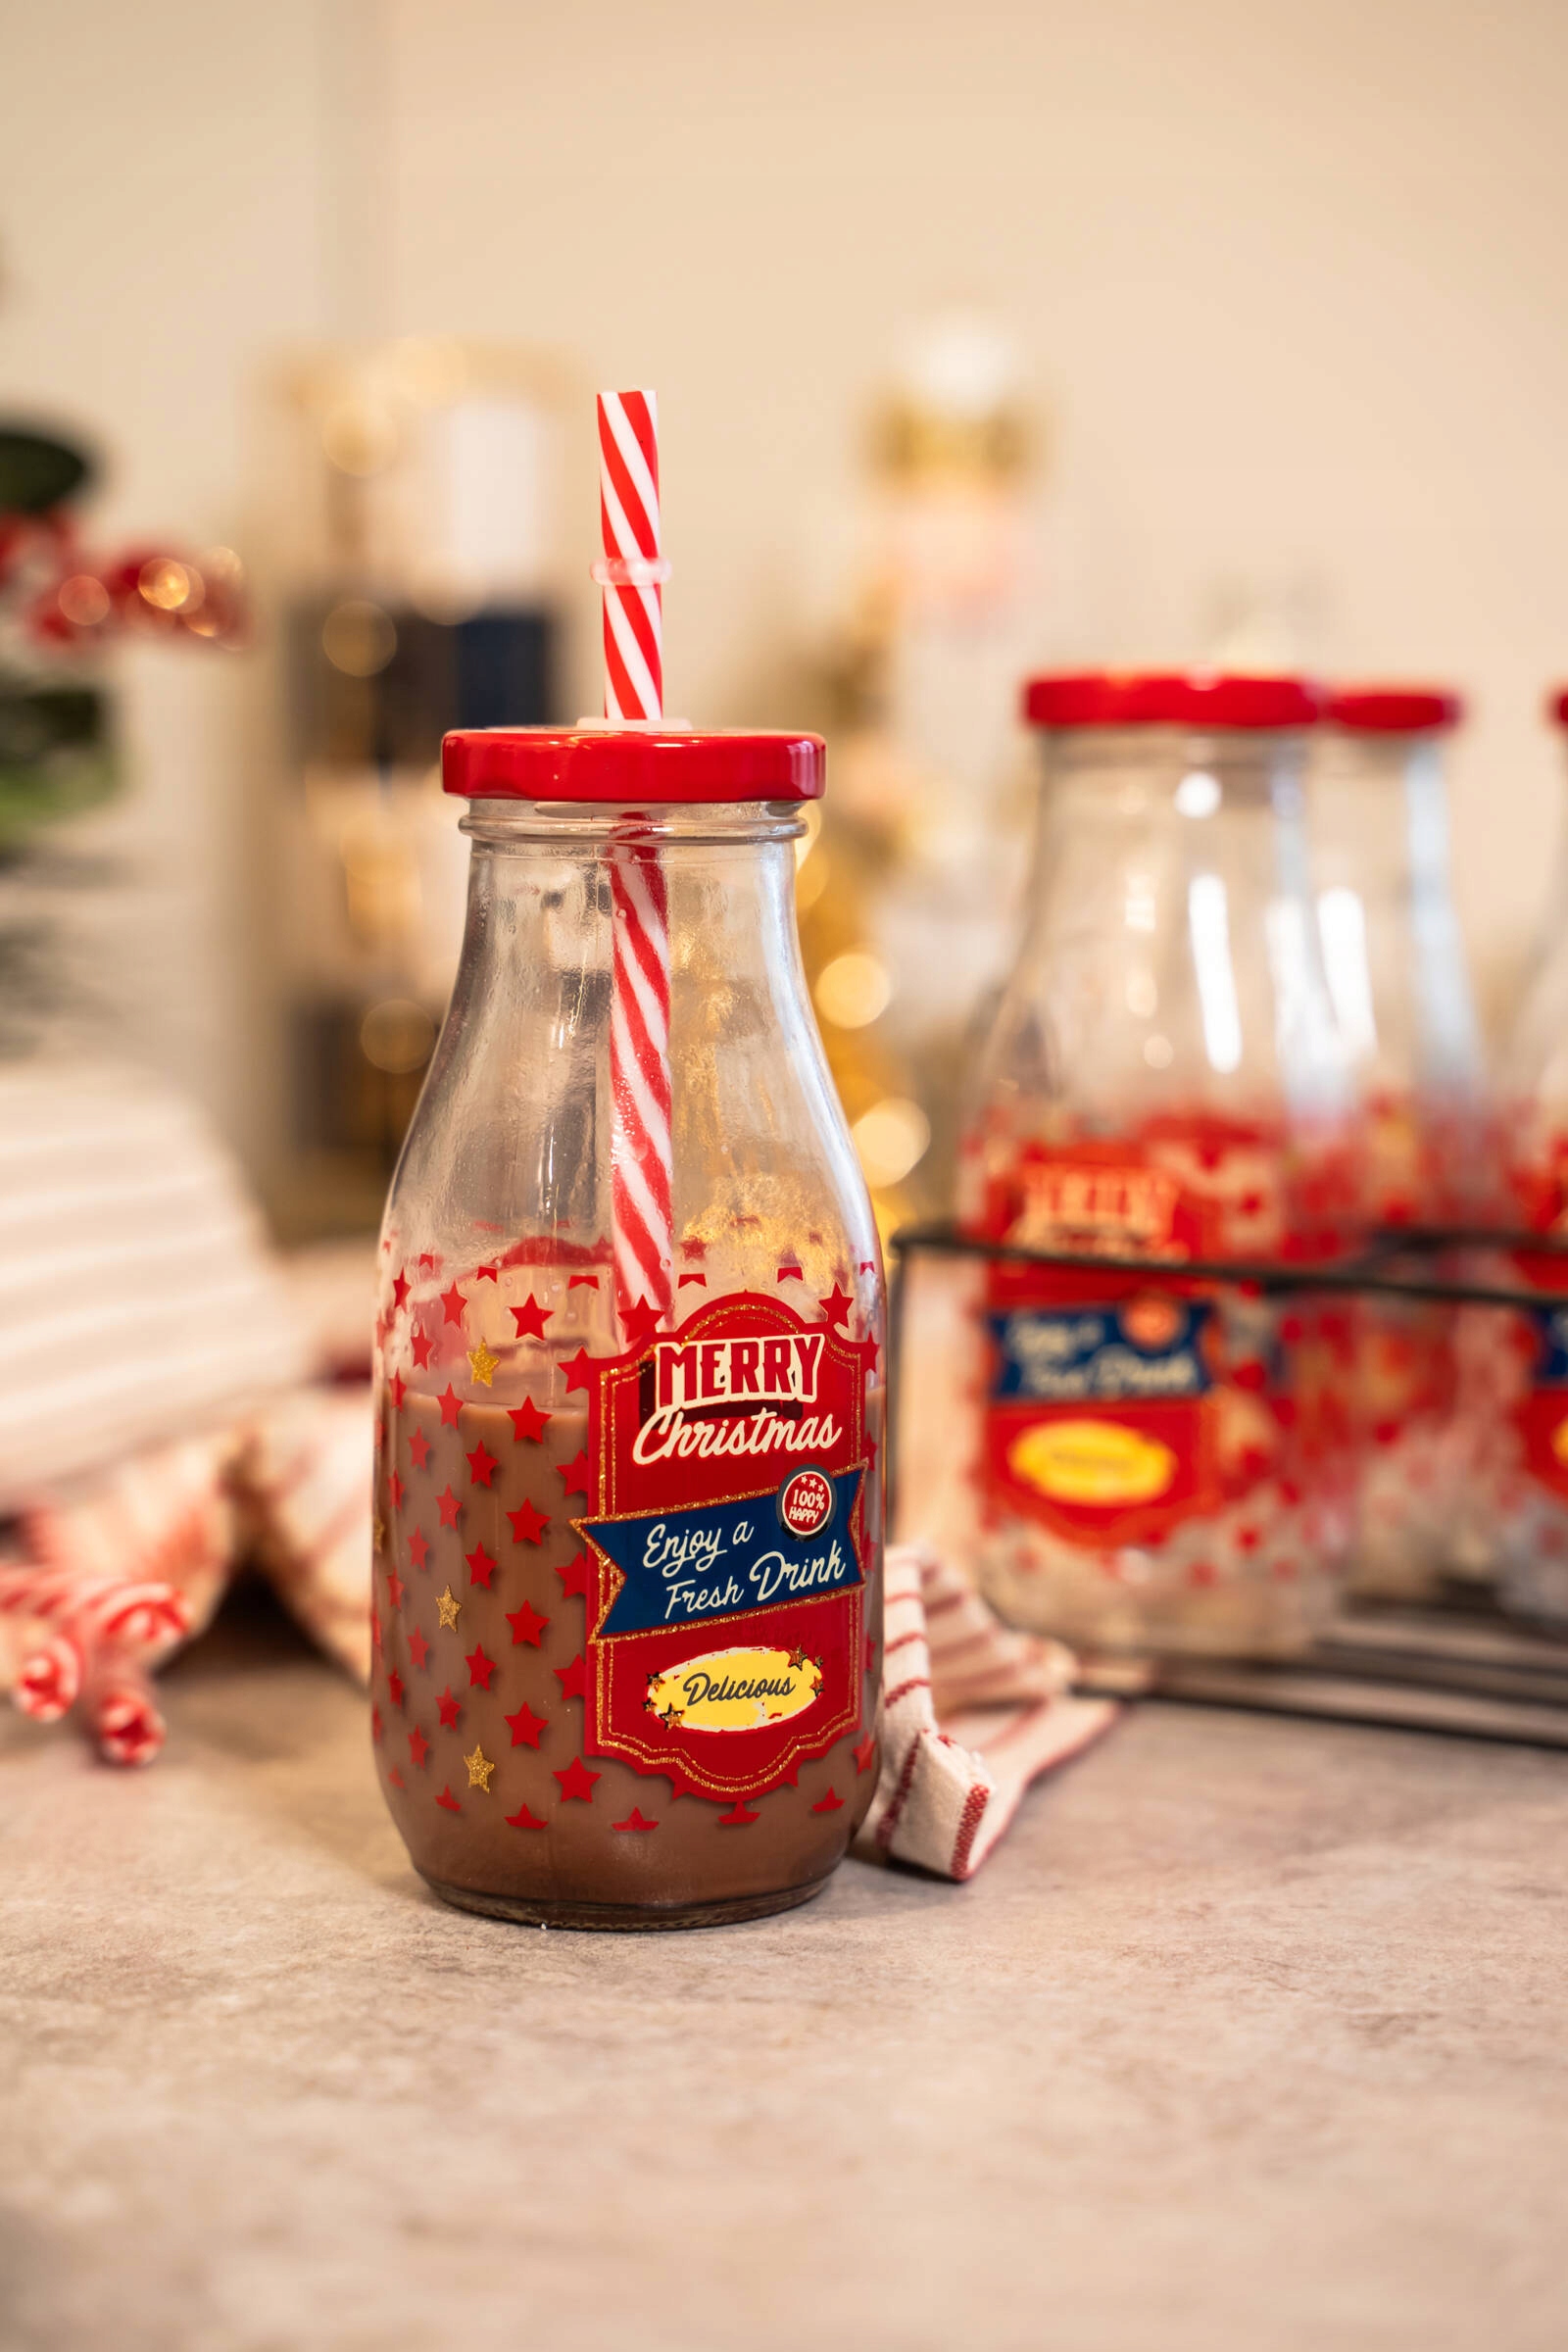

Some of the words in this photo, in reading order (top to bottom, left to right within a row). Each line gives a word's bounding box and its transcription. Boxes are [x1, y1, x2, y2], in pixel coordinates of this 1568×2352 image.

[655, 1334, 825, 1411] MERRY
[633, 1406, 842, 1465] Christmas
[788, 1505, 819, 1525] HAPPY
[792, 1488, 825, 1510] 100%
[643, 1522, 728, 1579] Enjoy
[732, 1519, 755, 1546] a
[663, 1578, 745, 1620] Fresh
[749, 1540, 846, 1601] Drink
[683, 1672, 795, 1706] Delicious
